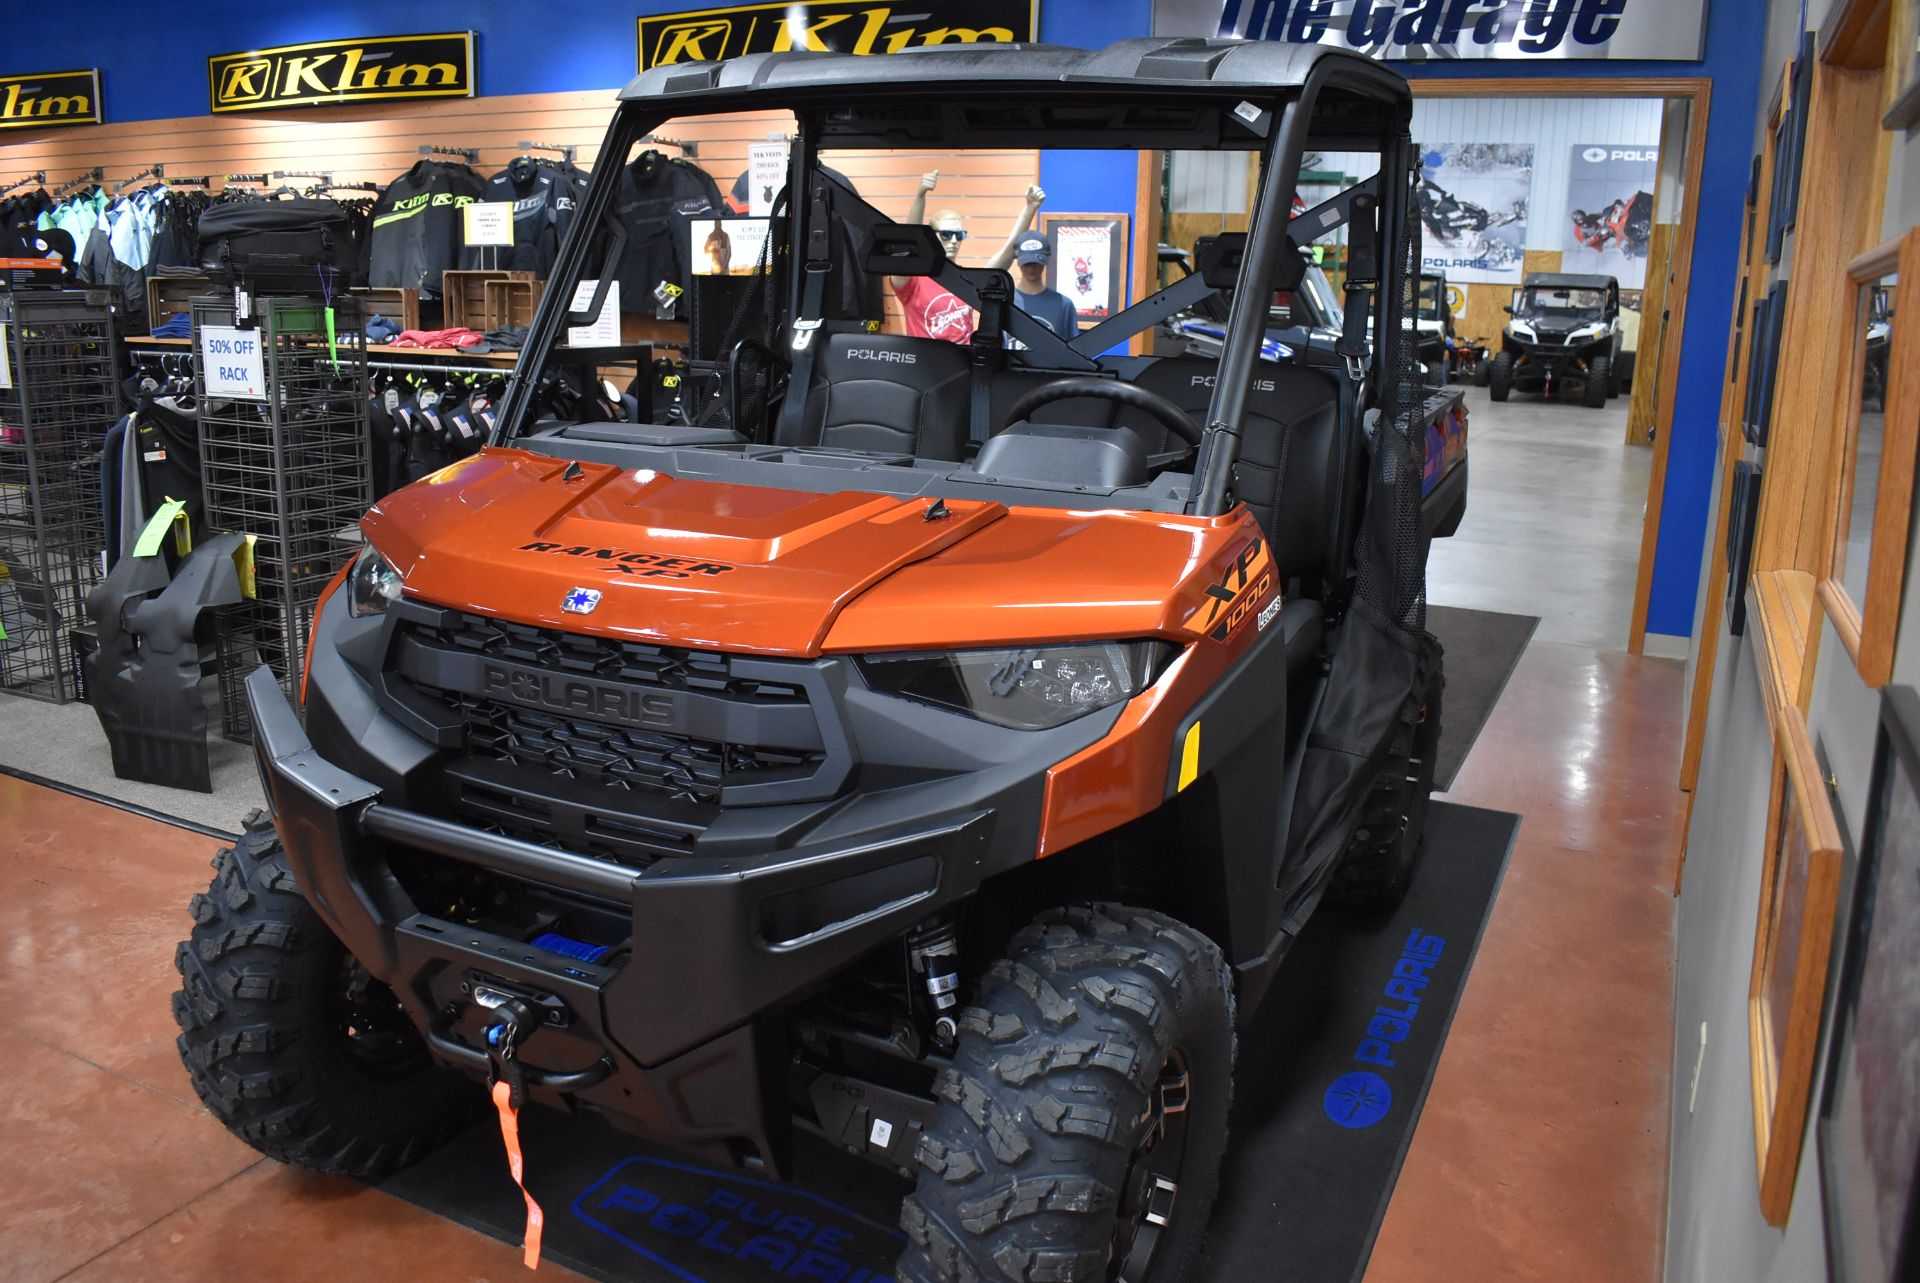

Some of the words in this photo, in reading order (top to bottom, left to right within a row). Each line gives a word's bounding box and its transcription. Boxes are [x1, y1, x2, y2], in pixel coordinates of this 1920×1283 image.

[221, 66, 267, 98] K
[281, 49, 460, 97] Klim
[0, 84, 91, 119] lim
[1611, 151, 1657, 161] POLA
[1422, 257, 1489, 269] POLARIS
[209, 339, 232, 354] 50%
[233, 340, 255, 355] OFF
[847, 349, 917, 364] POLARIS
[219, 366, 249, 382] RACK
[1191, 375, 1275, 392] POIS
[518, 542, 734, 575] RANGER
[597, 563, 691, 578] XP
[1204, 536, 1262, 629] XP
[1226, 572, 1270, 634] 1000
[484, 663, 676, 727] POLARIS
[1353, 927, 1446, 1069] POLARIS
[705, 1188, 854, 1252] PURE
